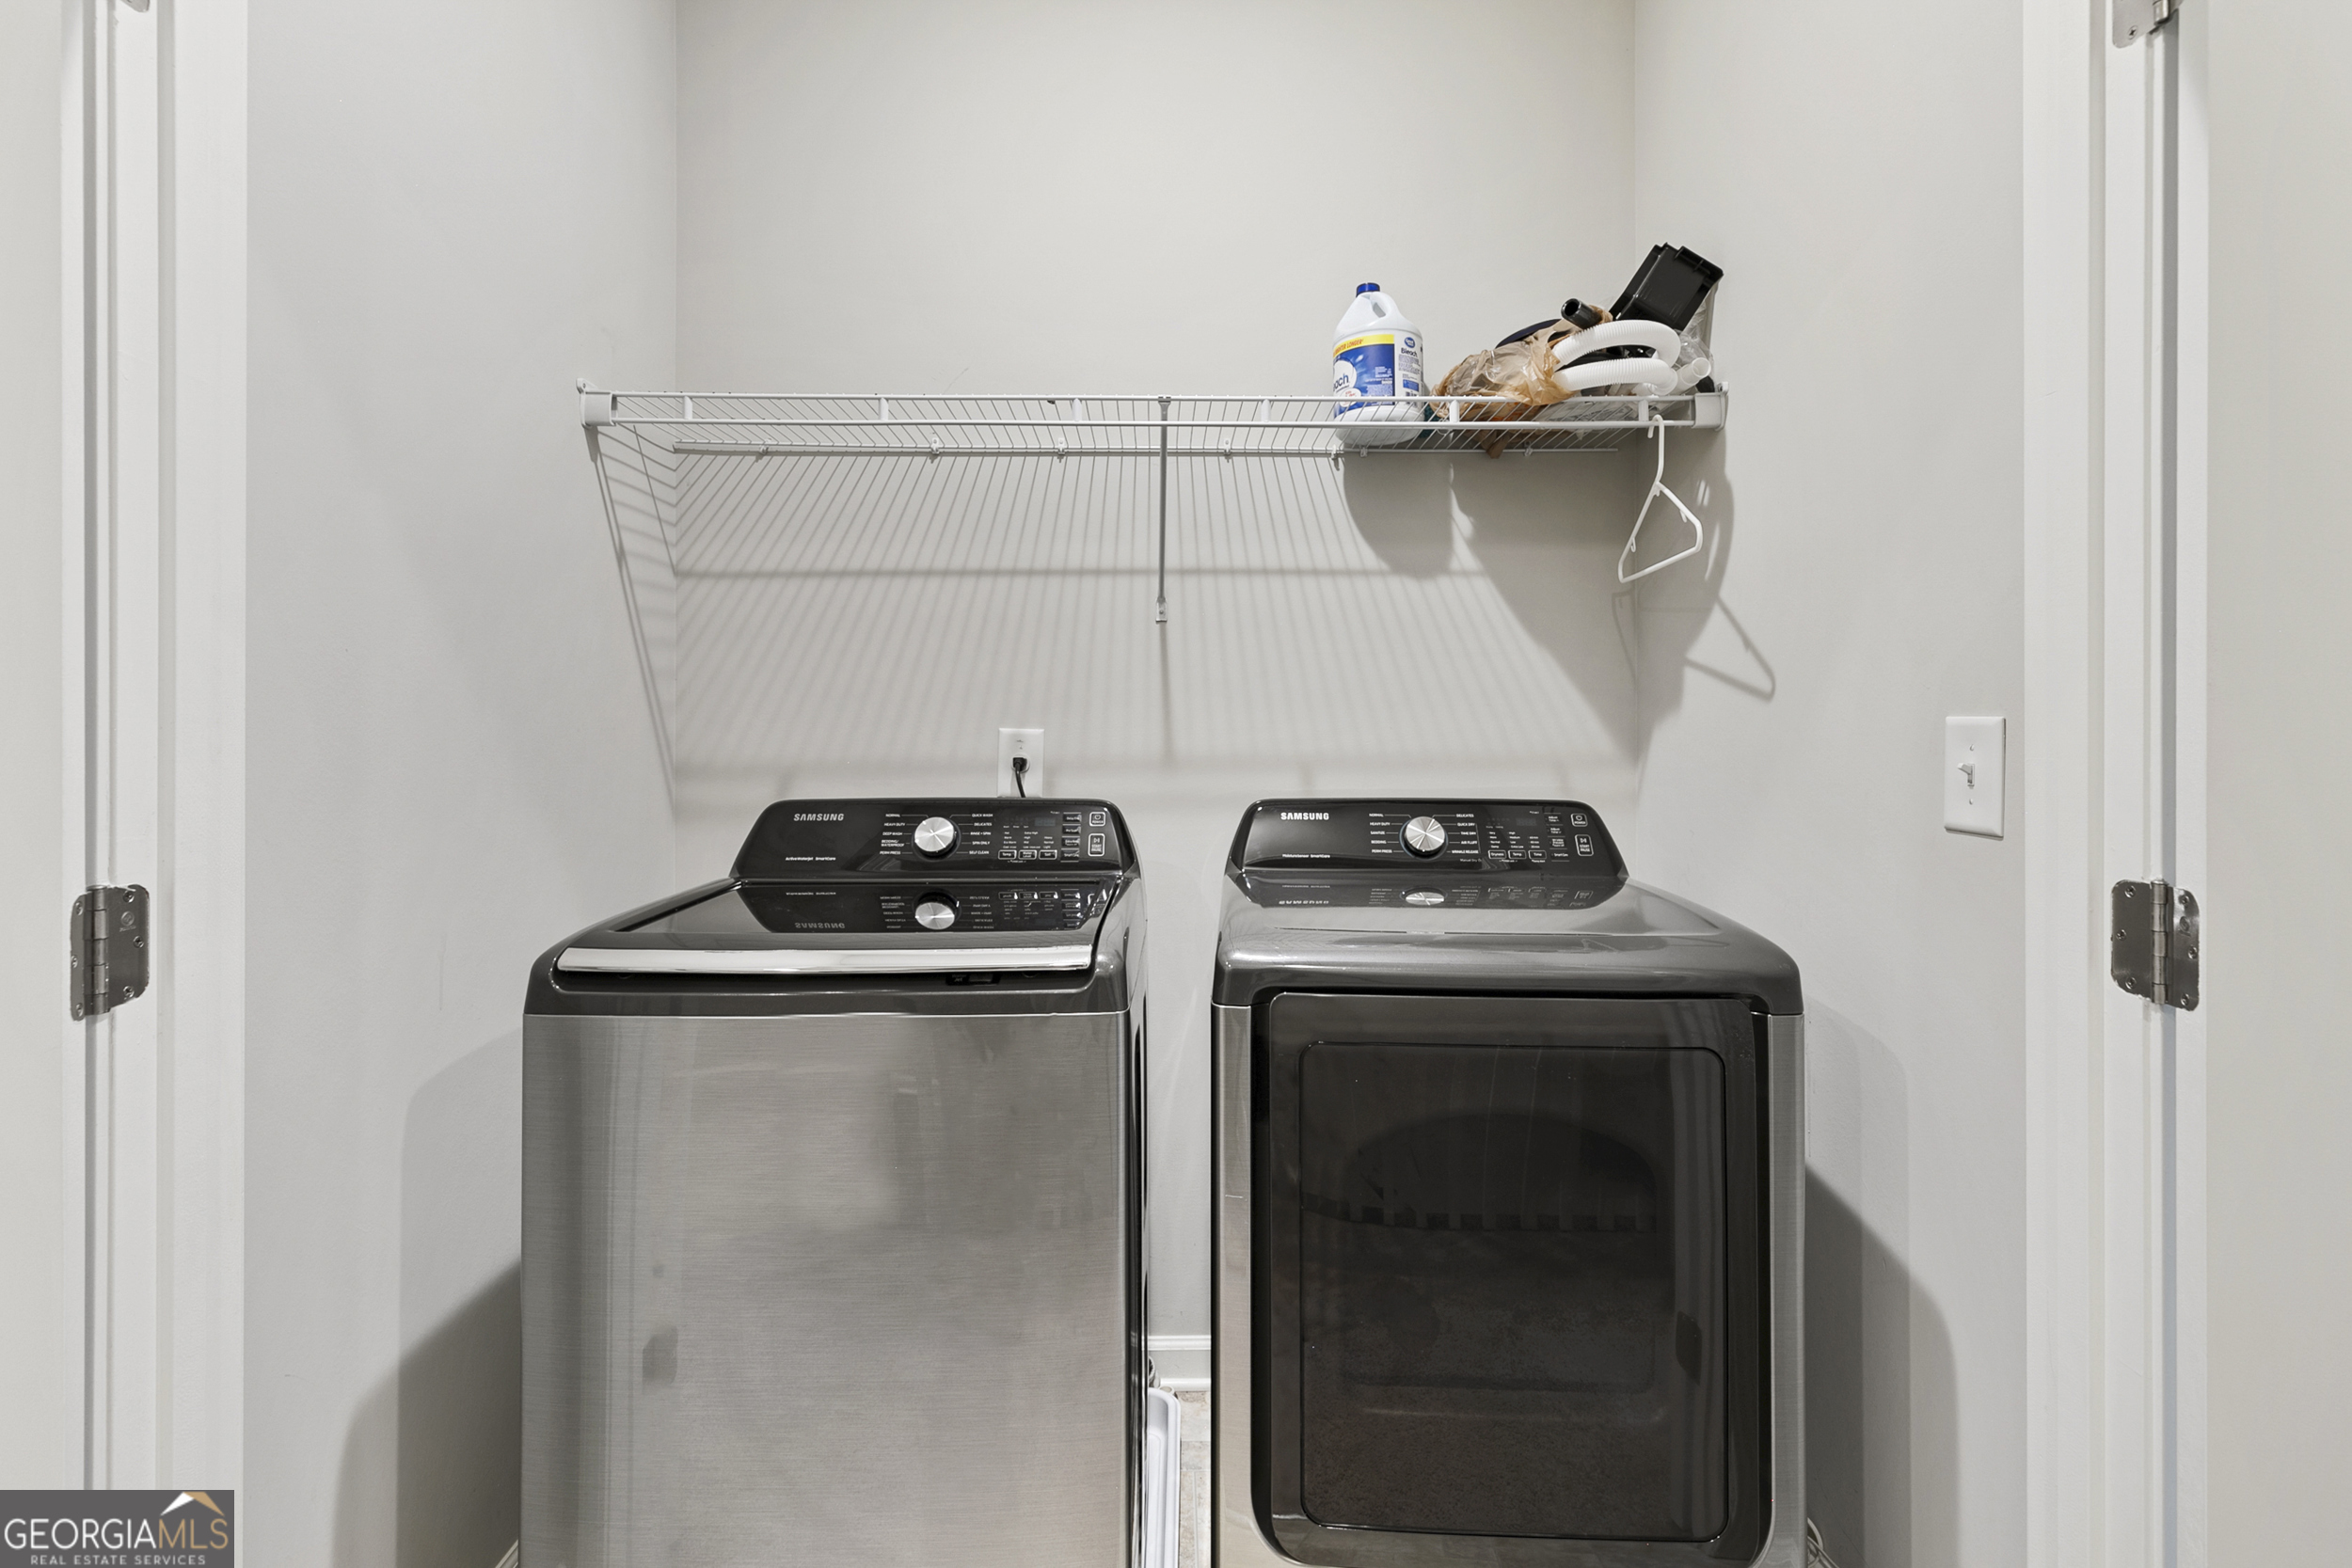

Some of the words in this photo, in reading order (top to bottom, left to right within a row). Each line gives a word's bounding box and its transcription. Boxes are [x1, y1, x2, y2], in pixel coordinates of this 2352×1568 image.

[1401, 347, 1418, 357] Bleach
[793, 813, 845, 821] SAMSUNG
[1280, 812, 1329, 820] SAMSUNG
